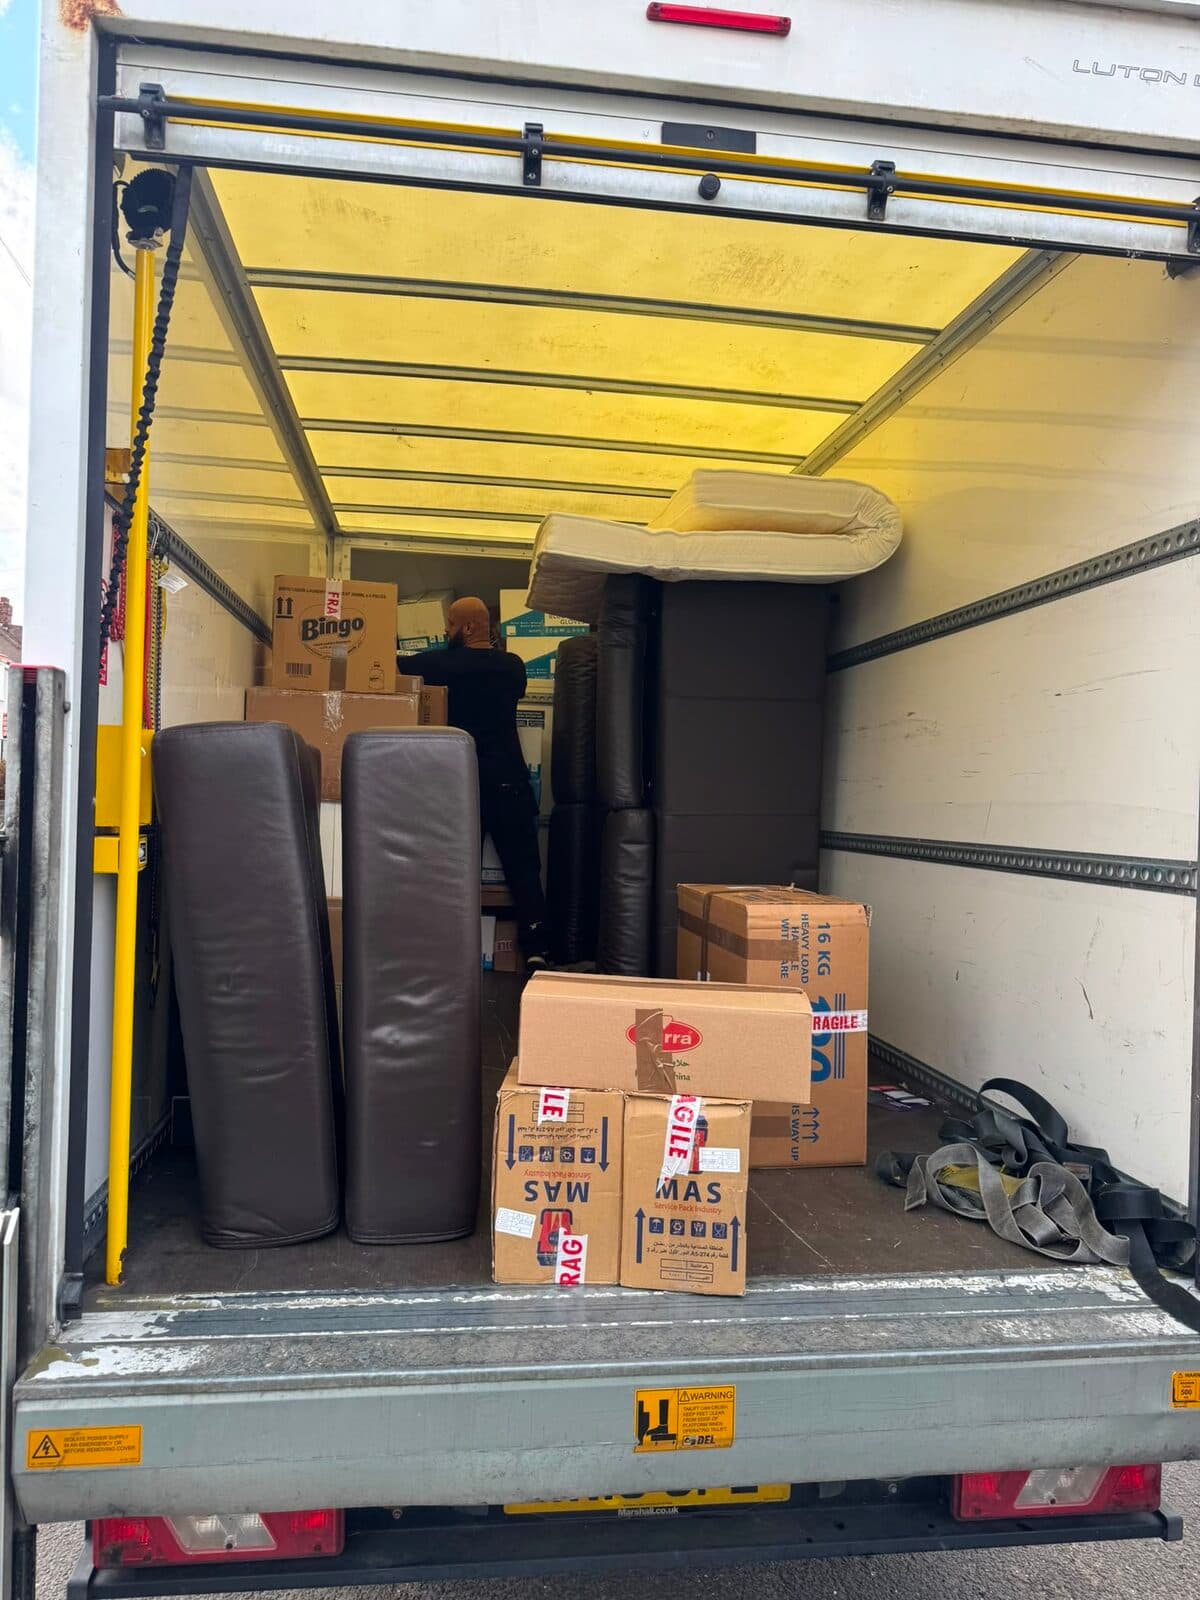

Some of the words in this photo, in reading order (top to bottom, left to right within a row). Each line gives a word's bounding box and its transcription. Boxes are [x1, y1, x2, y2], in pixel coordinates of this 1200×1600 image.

[1072, 59, 1187, 86] LUTON
[301, 617, 364, 641] Bingo
[780, 918, 789, 941] WIT
[800, 913, 809, 950] HEAVY
[817, 922, 831, 944] 16
[790, 926, 799, 972] HALE
[780, 959, 789, 980] ARE
[800, 953, 809, 984] LOAD
[816, 951, 831, 976] KG
[813, 1015, 858, 1031] RAGILE
[664, 1033, 692, 1045] rra
[673, 1072, 691, 1081] hina
[790, 1104, 800, 1115] IS
[668, 1094, 697, 1159] AGILE
[790, 1118, 800, 1144] WAY
[790, 1146, 800, 1161] UP
[524, 1180, 590, 1203] MAS
[655, 1178, 722, 1204] MAS
[654, 1202, 677, 1210] Service
[678, 1204, 695, 1212] Pack
[559, 1239, 583, 1286] RAG
[691, 1391, 733, 1400] WARNING
[618, 1506, 679, 1517] Marshall.co.uk
